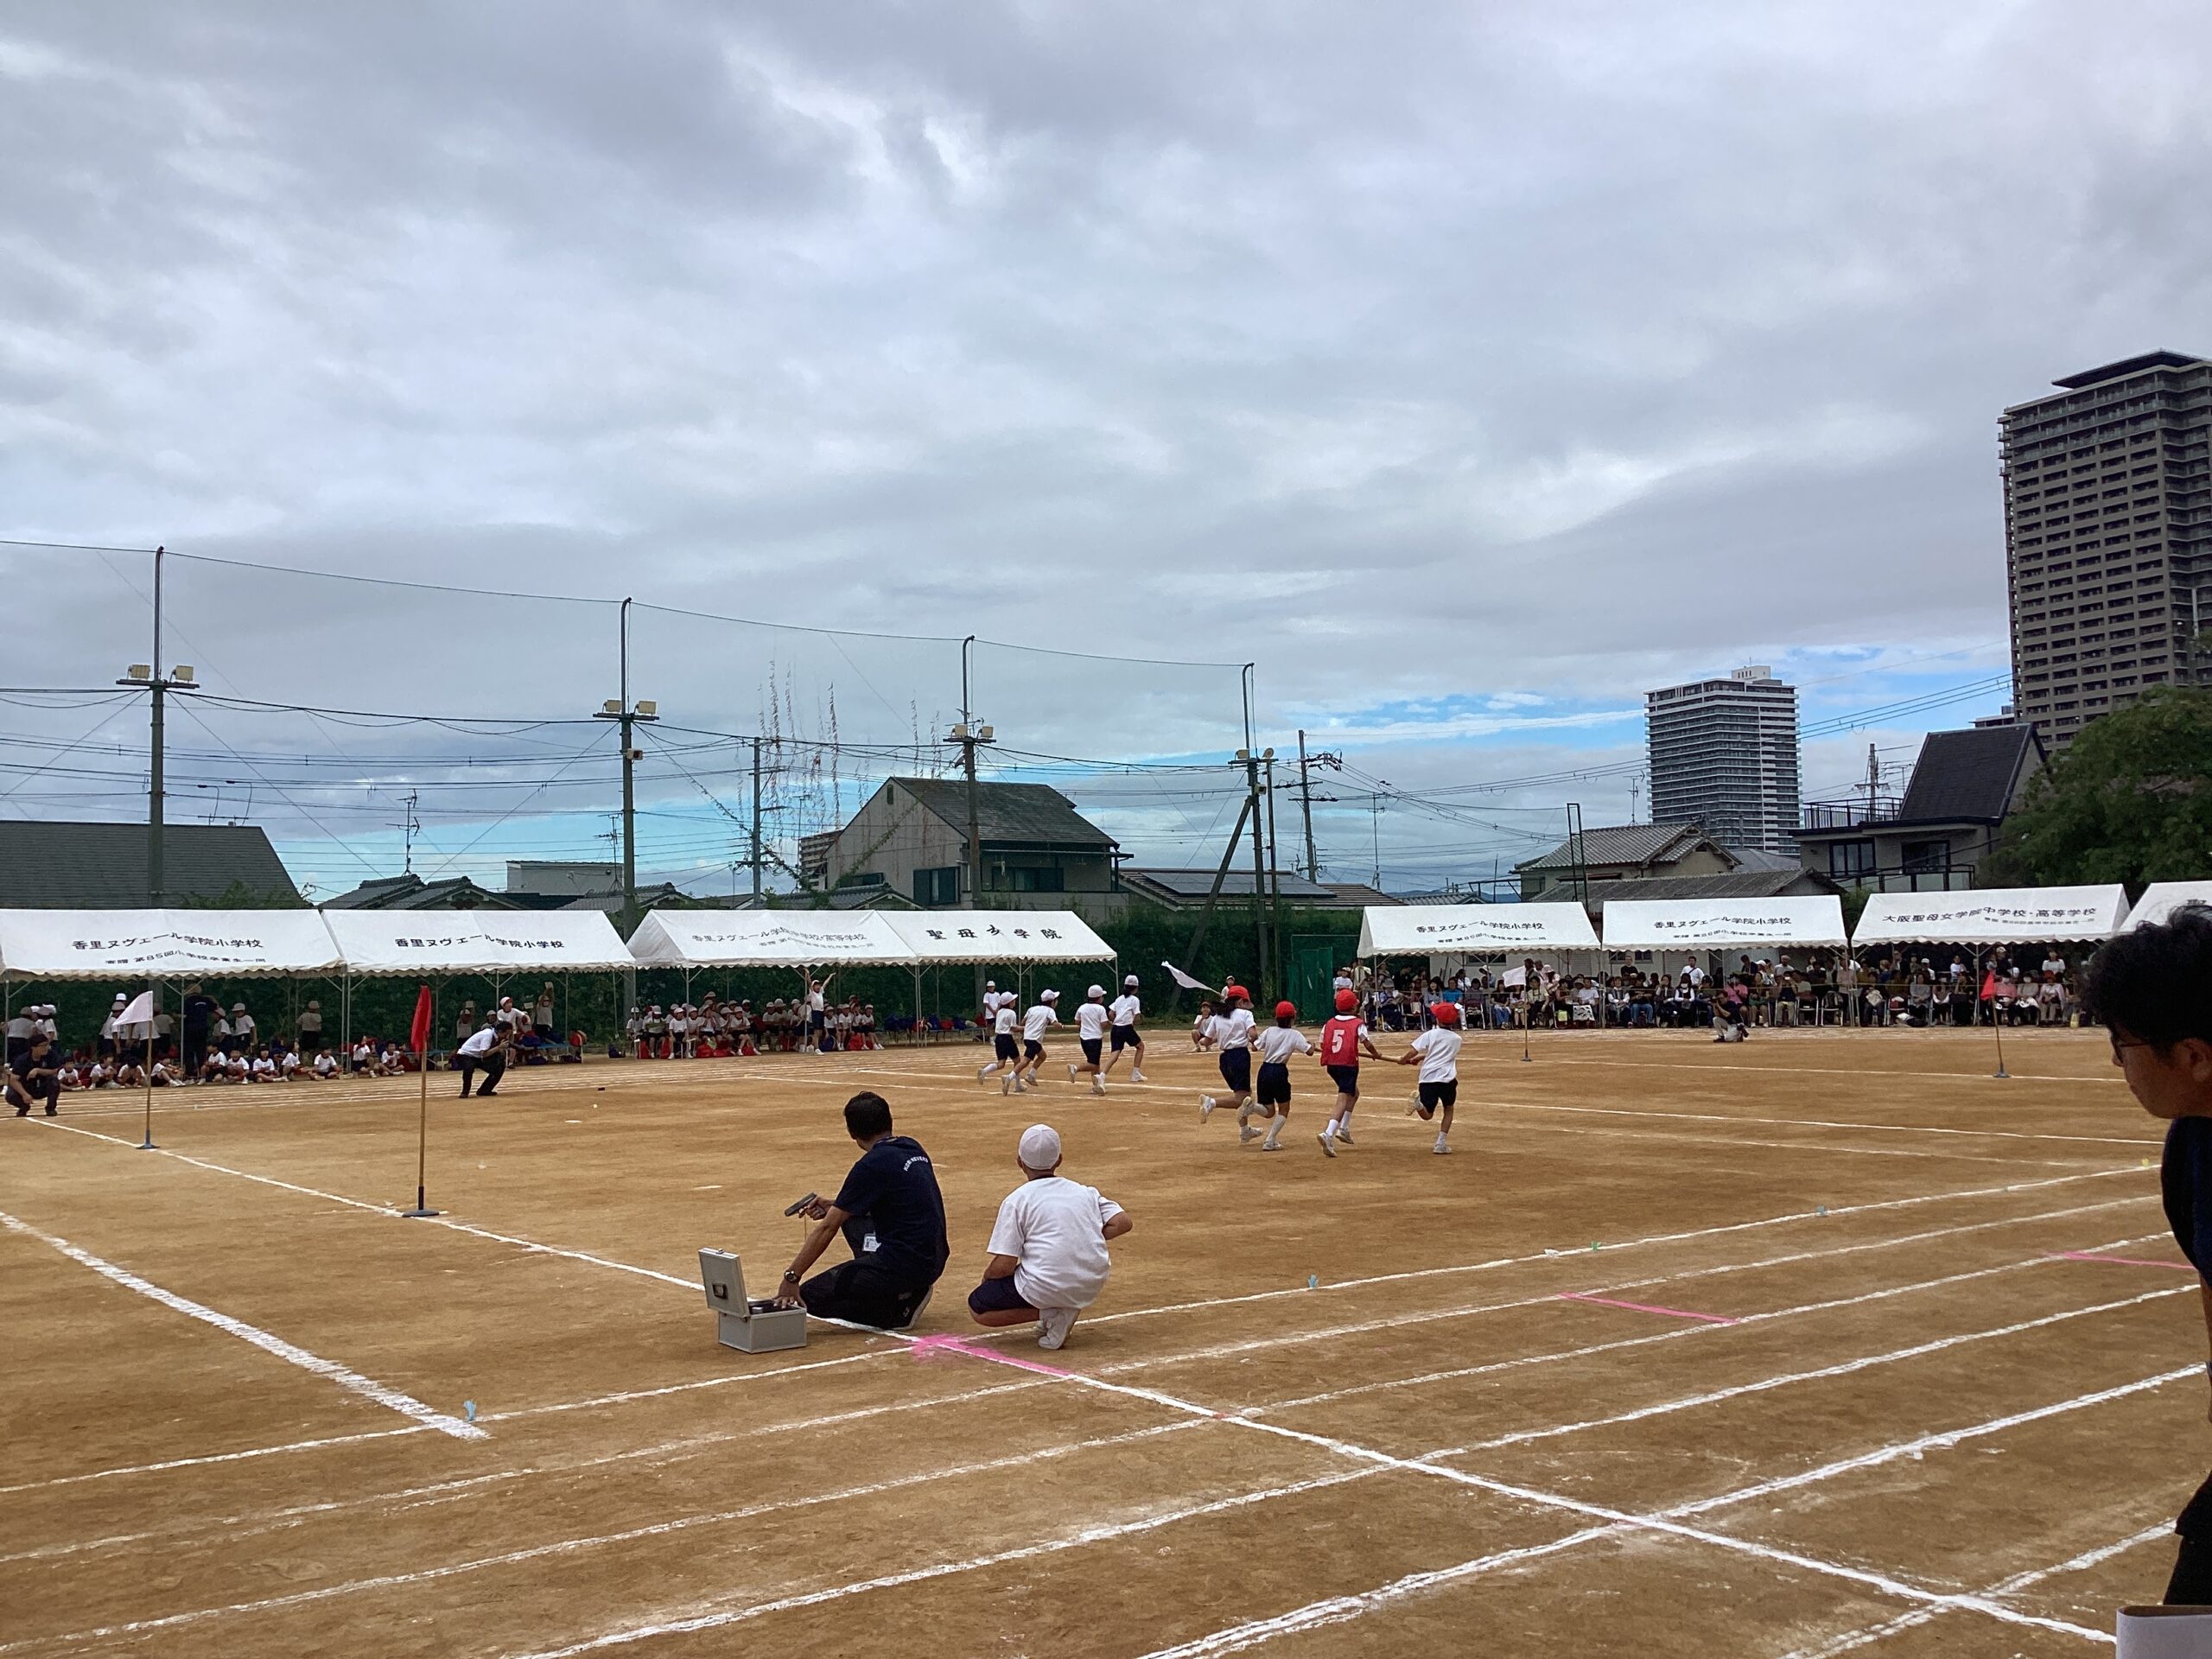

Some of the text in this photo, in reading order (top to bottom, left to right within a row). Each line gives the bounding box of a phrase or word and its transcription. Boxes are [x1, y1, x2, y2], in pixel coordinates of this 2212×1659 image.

[1416, 920, 1545, 933] 香里ヌヴェール学院小学校
[1654, 916, 1792, 929] 香里ヌヴェール学院小学校
[71, 932, 264, 950] 香里ヌヴェール学院小学校
[395, 934, 564, 949] 香里ヌヴェール学院小学校
[1332, 1029, 1345, 1053] 5
